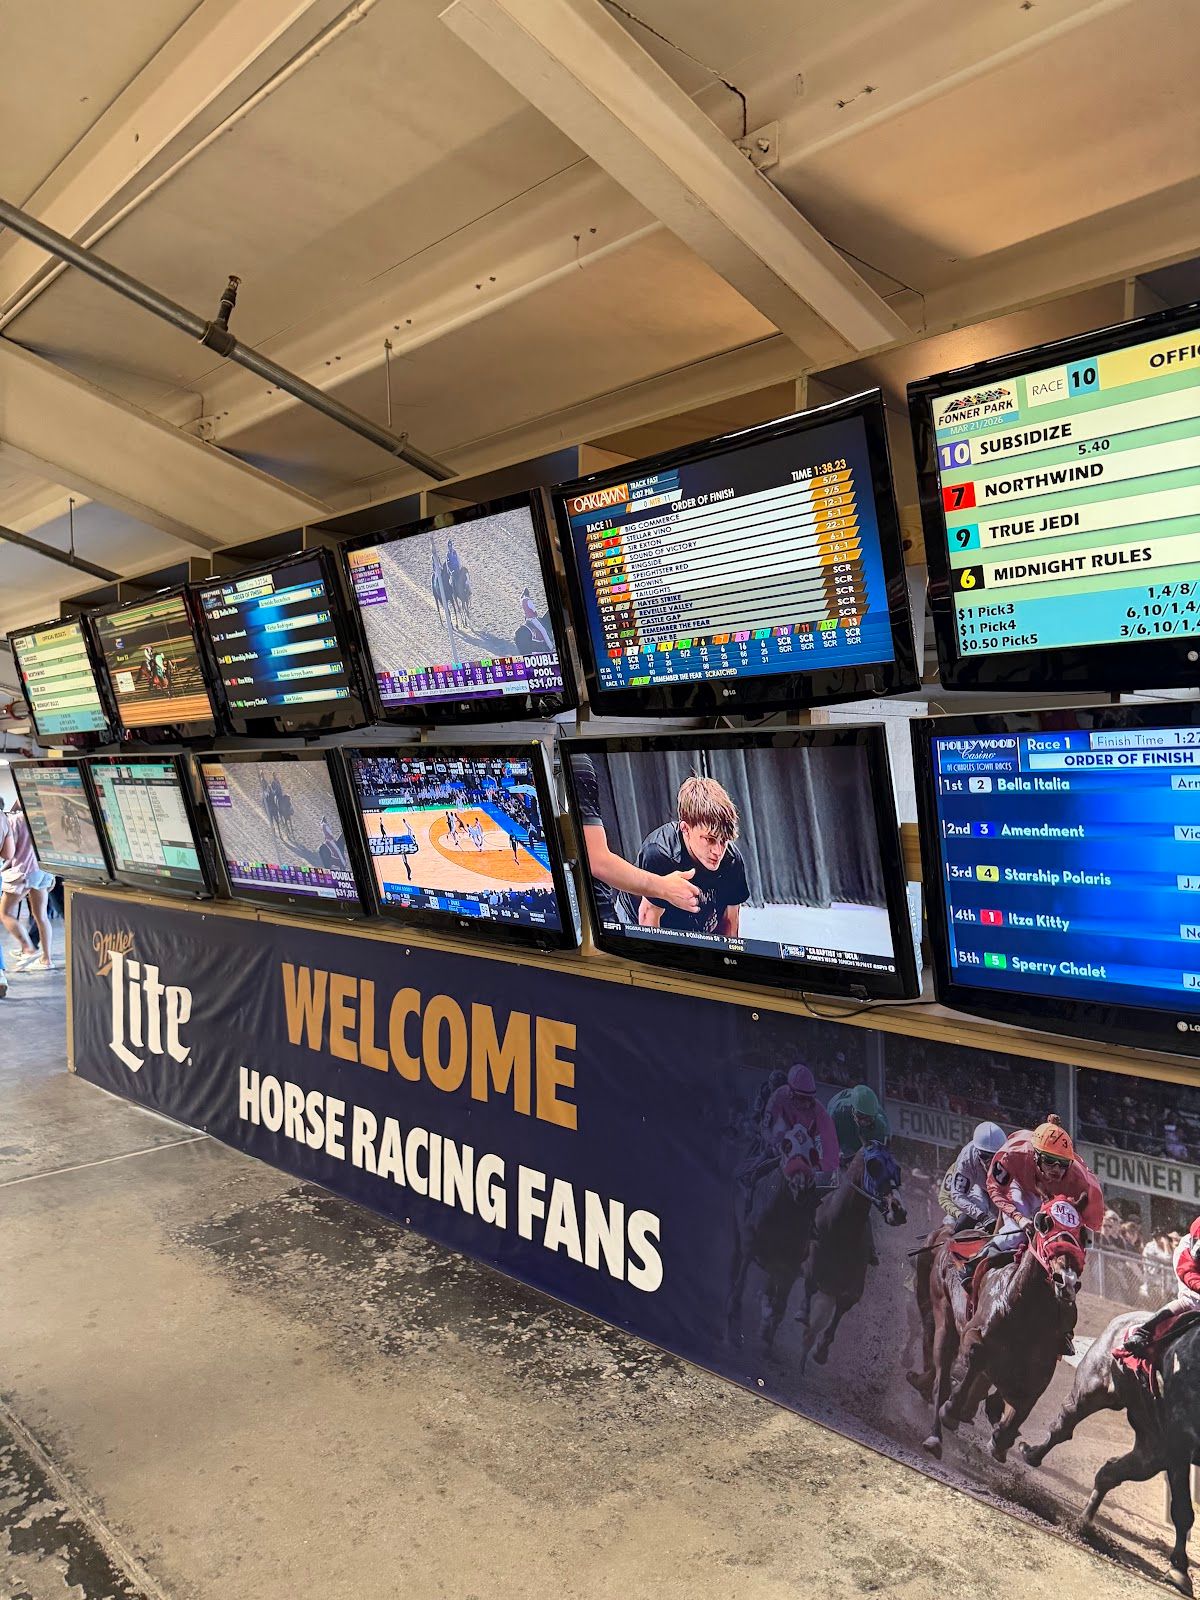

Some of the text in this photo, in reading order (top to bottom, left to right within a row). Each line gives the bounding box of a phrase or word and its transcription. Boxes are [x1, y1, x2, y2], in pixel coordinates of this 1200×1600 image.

[1032, 344, 1200, 396] RACE 10 OFFI
[938, 398, 1014, 426] FONNER PARK
[950, 416, 1004, 435] MAR 21/2026
[941, 422, 1072, 467] 10 SUBSIDIZE
[1078, 439, 1110, 455] 5.40
[791, 459, 847, 481] TIME 1:38.23
[951, 463, 1104, 507] 7 NORTHWIND
[574, 487, 626, 512] OAKLAWN
[627, 486, 840, 541] STELLAR VINO 9/5
[638, 514, 680, 529] COMMERCE
[823, 475, 838, 484] 5/2
[672, 488, 735, 511] ORDER OF FINISH
[586, 519, 613, 533] RACE 11
[630, 551, 653, 560] SOUND
[666, 541, 697, 552] VICTORY
[828, 509, 841, 517] 5-1
[640, 540, 662, 549] EXTON
[824, 497, 843, 506] 12-1
[956, 512, 1080, 548] 9 TRUE JEDI
[631, 520, 845, 569] RINGSIDE 22-1
[633, 532, 844, 579] SPEIGHTSTER RED 6-1
[635, 542, 848, 588] MOWINS 16-1
[636, 554, 847, 598] TAILLIGHTS 6-1
[960, 548, 1152, 589] 6 MIDNIGHT RULES
[638, 598, 659, 606] HAYES
[661, 595, 681, 603] STRIKE
[833, 564, 851, 573] SCR
[640, 607, 666, 616] REVEILLE
[668, 602, 693, 611] VALLEY
[835, 575, 853, 584] SCR
[641, 617, 664, 625] CASTLE
[836, 585, 854, 595] SCR
[642, 623, 677, 634] REMEMBER
[837, 596, 856, 605] SCR
[839, 608, 857, 616] SCR
[978, 604, 1015, 618] Pick3
[980, 619, 1017, 634] Pick4
[962, 637, 998, 651] $0.50
[1002, 634, 1038, 647] Pick5
[524, 653, 559, 668] DOUBLE
[534, 668, 554, 677] POOL
[705, 669, 737, 678] SCRATCHED
[529, 677, 563, 690] $31,078
[940, 739, 1016, 752] HOLLYWOOD
[1027, 738, 1060, 751] Race
[1065, 737, 1071, 749] 1
[1097, 736, 1130, 747] Finish
[1135, 734, 1164, 746] Time
[960, 748, 1194, 766] Casino ORDER OF FINISH
[977, 763, 993, 772] TOWN
[995, 762, 1012, 771] RACES
[944, 779, 963, 791] 1st
[977, 780, 985, 790] 2
[998, 778, 1031, 791] Bella
[1035, 778, 1070, 790] Italia
[948, 823, 970, 834] 2nd
[980, 824, 988, 834] 3
[1001, 824, 1084, 838] Amendment
[951, 866, 1111, 886] 3rd 4 Starship Polaris
[604, 922, 621, 930] ESPN
[955, 910, 1069, 932] 4th 1 Itza Kitty
[93, 930, 136, 962] Miller
[959, 951, 1106, 979] 5th 5 Sperry Chalet
[108, 950, 192, 1072] Lite
[281, 962, 578, 1131] WELCOME
[239, 1066, 664, 1293] HORSE RACING FANS
[1093, 1151, 1182, 1194] FONNER
